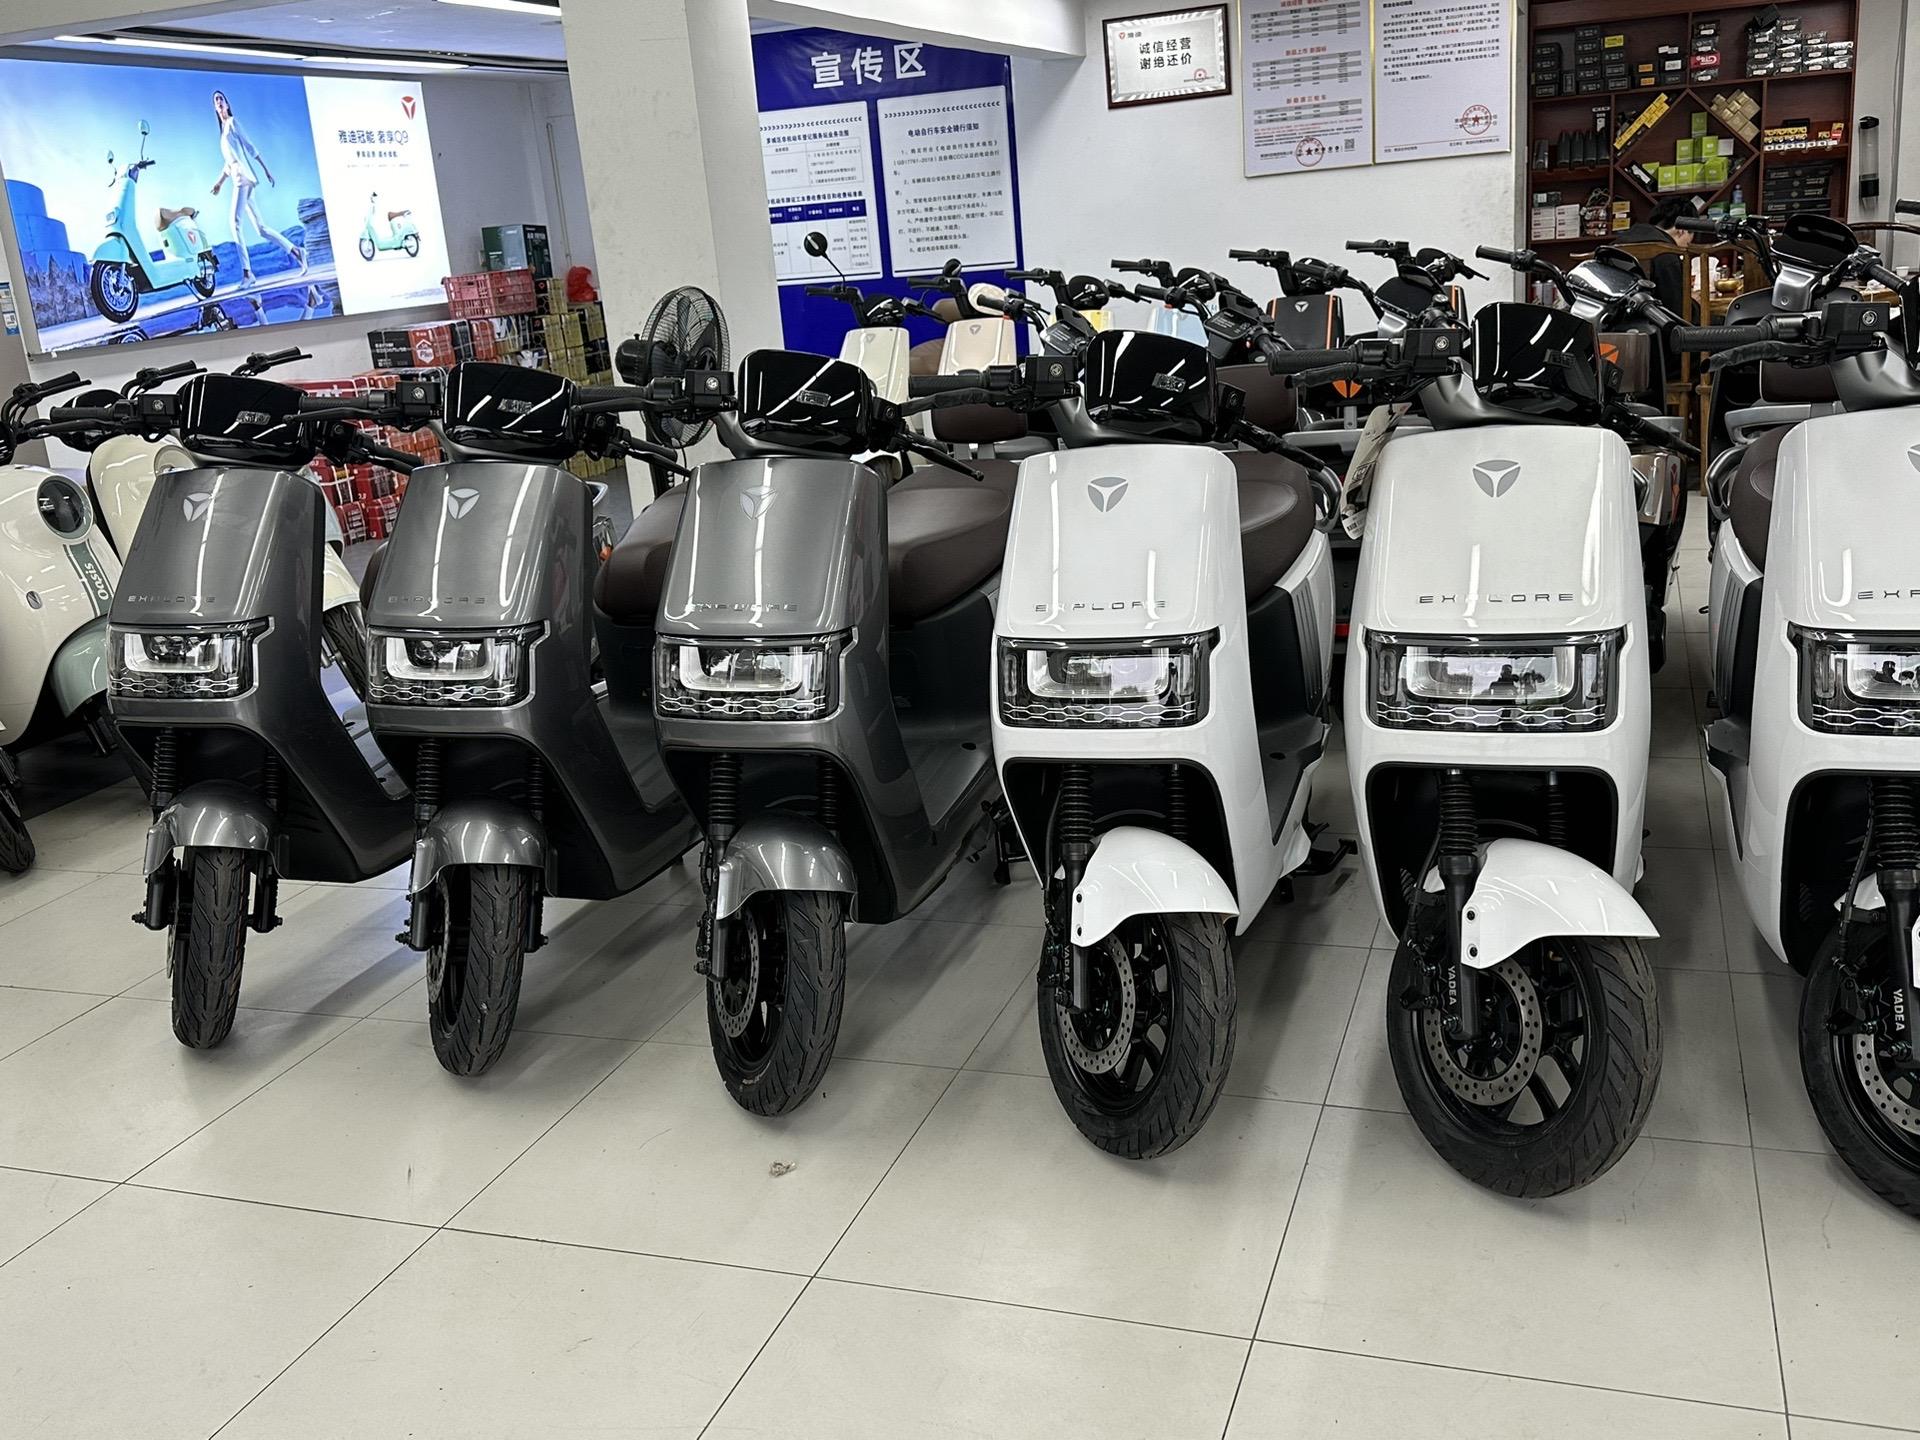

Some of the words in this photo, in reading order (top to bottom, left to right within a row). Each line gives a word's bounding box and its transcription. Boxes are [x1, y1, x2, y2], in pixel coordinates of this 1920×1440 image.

[1139, 36, 1191, 55] 诚信经营
[811, 42, 926, 89] 宣传区
[1139, 52, 1192, 70] 谢绝还价
[338, 129, 375, 144] 雅迪冠能
[377, 129, 409, 145] 奢享Q9
[908, 122, 980, 138] 电动自行车安全骑行须知
[84, 562, 109, 600] Oasis
[1419, 593, 1574, 604] EXLORE
[1448, 965, 1457, 1006] YADEA
[1893, 988, 1905, 1032] YADEA
